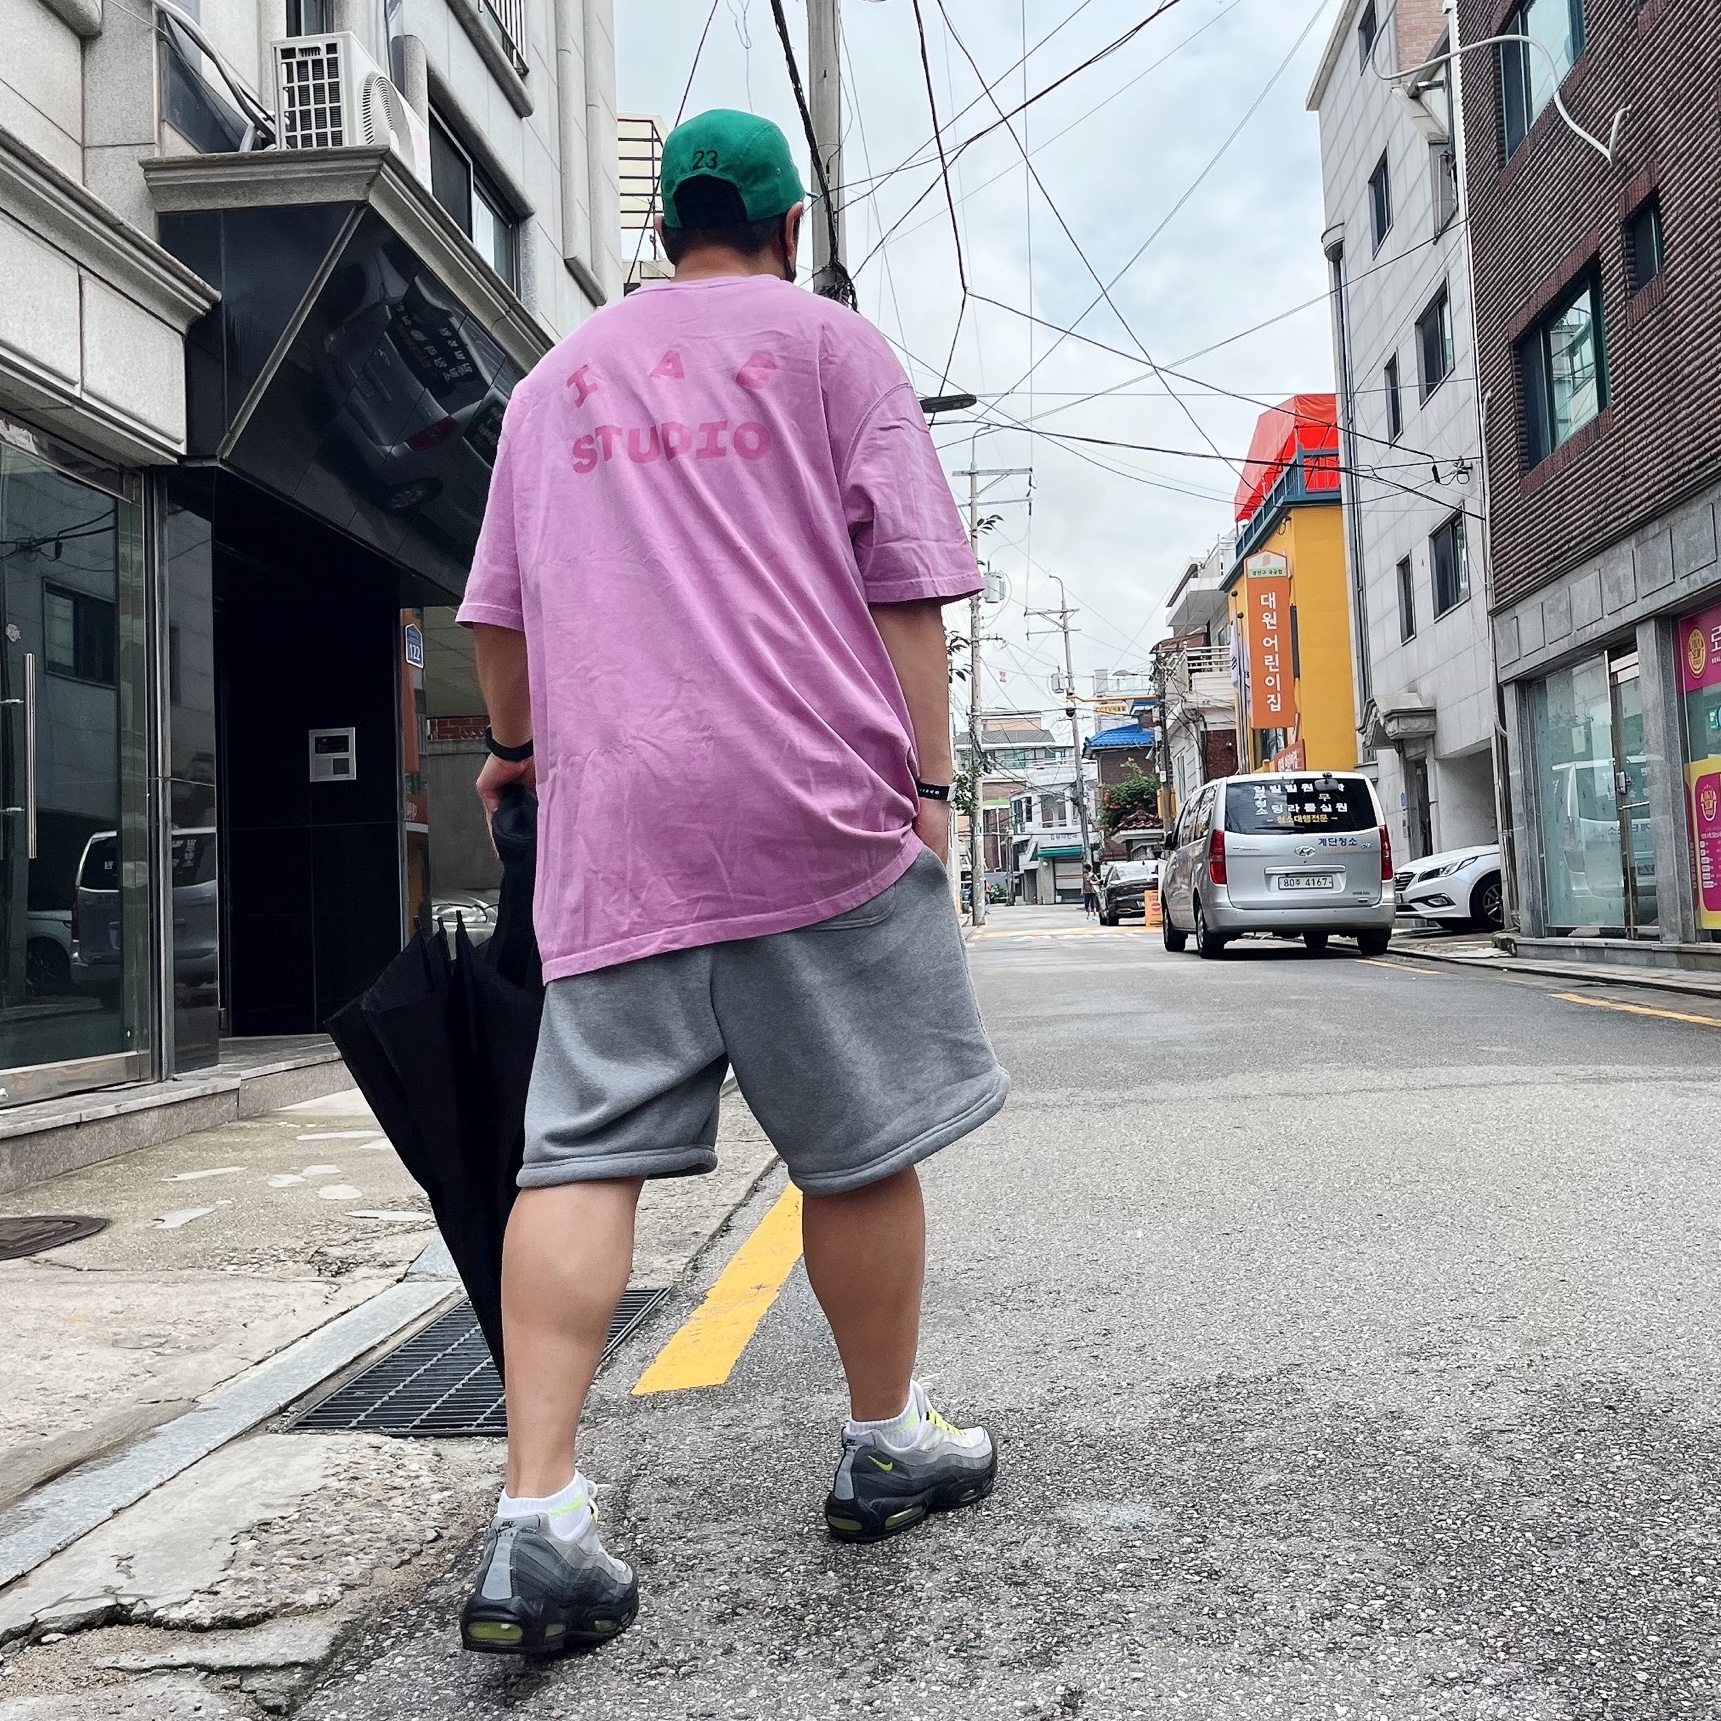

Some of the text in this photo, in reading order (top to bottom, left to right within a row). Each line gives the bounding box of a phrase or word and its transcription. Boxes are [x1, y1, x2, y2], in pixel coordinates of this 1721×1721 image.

[693, 150, 718, 170] 23
[572, 421, 771, 474] STUDIO
[409, 643, 421, 661] 122
[1260, 592, 1282, 712] 대원 어린이집
[1318, 837, 1358, 847] 계단청소
[1304, 877, 1328, 887] 4167
